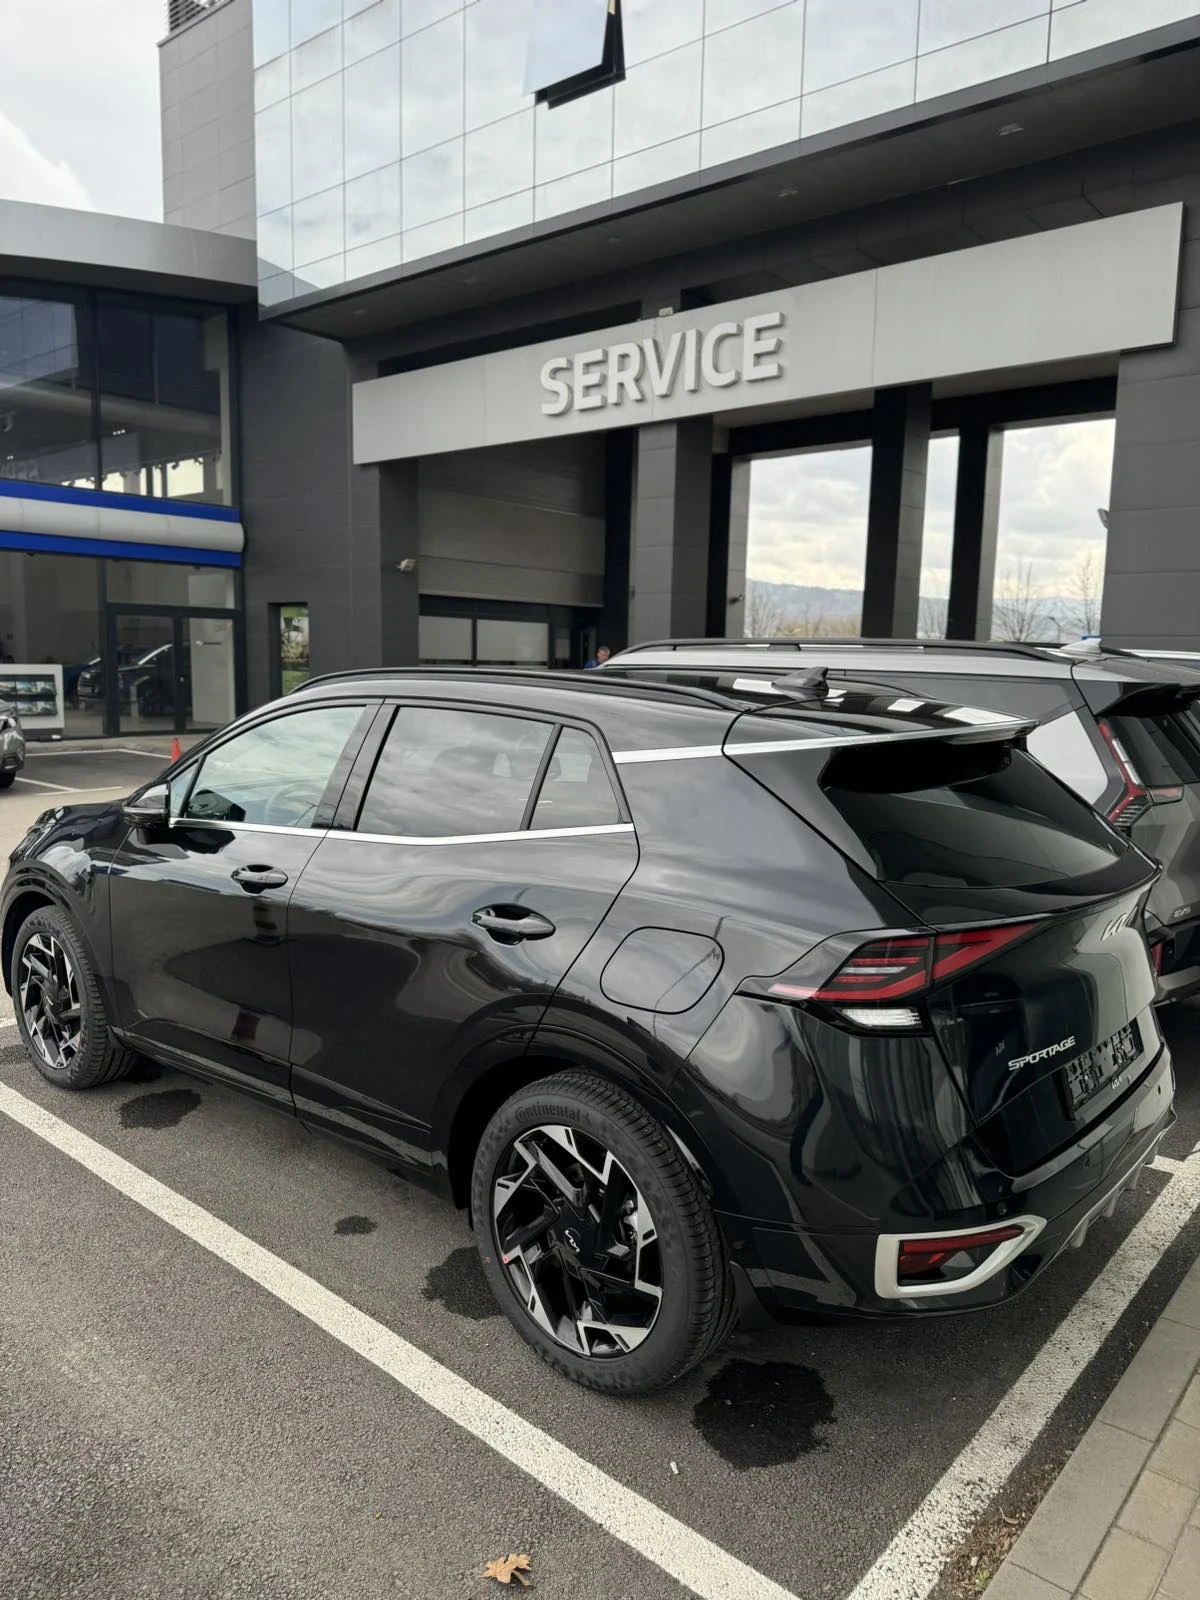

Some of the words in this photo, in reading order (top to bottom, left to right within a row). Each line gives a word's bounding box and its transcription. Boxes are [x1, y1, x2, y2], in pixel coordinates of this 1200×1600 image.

[540, 311, 784, 417] SERVICE
[1008, 1035, 1076, 1071] SPORTAGE
[515, 1102, 581, 1122] Continental
